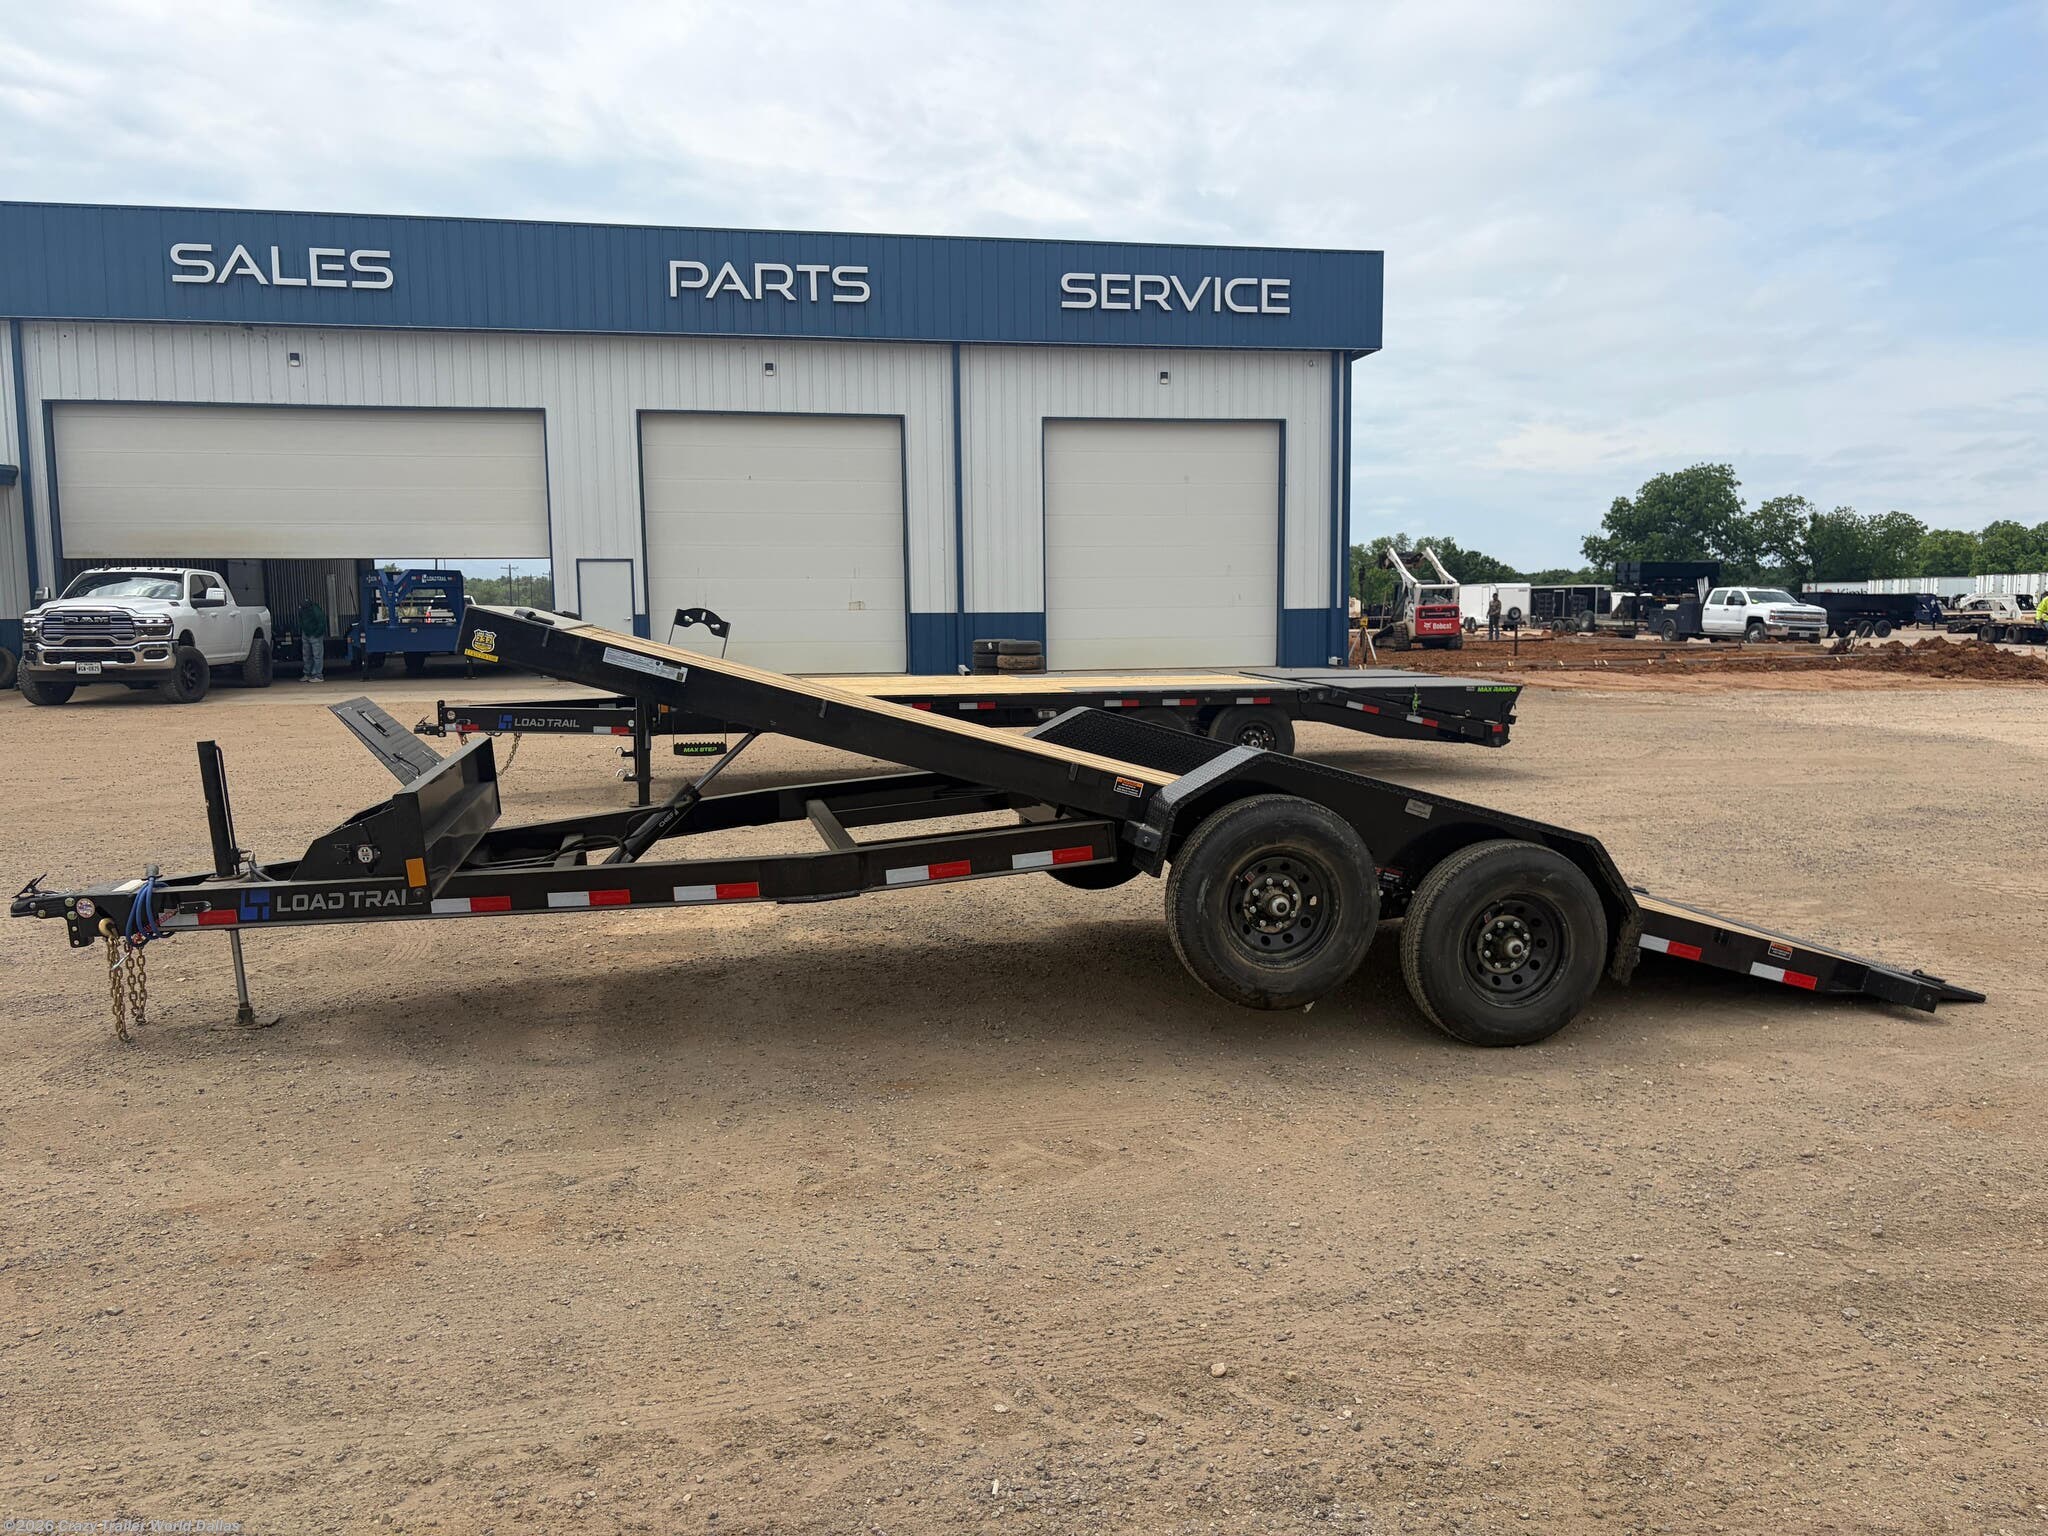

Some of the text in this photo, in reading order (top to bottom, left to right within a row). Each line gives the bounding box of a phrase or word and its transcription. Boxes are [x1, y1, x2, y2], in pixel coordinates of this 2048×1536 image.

[170, 243, 394, 289] SALES
[669, 260, 871, 303] PARTS
[1061, 272, 1291, 314] SERVICE
[1432, 622, 1452, 630] Bobcat
[514, 718, 545, 727] LOAD
[549, 718, 580, 728] TRAIL
[276, 892, 345, 913] LOAD
